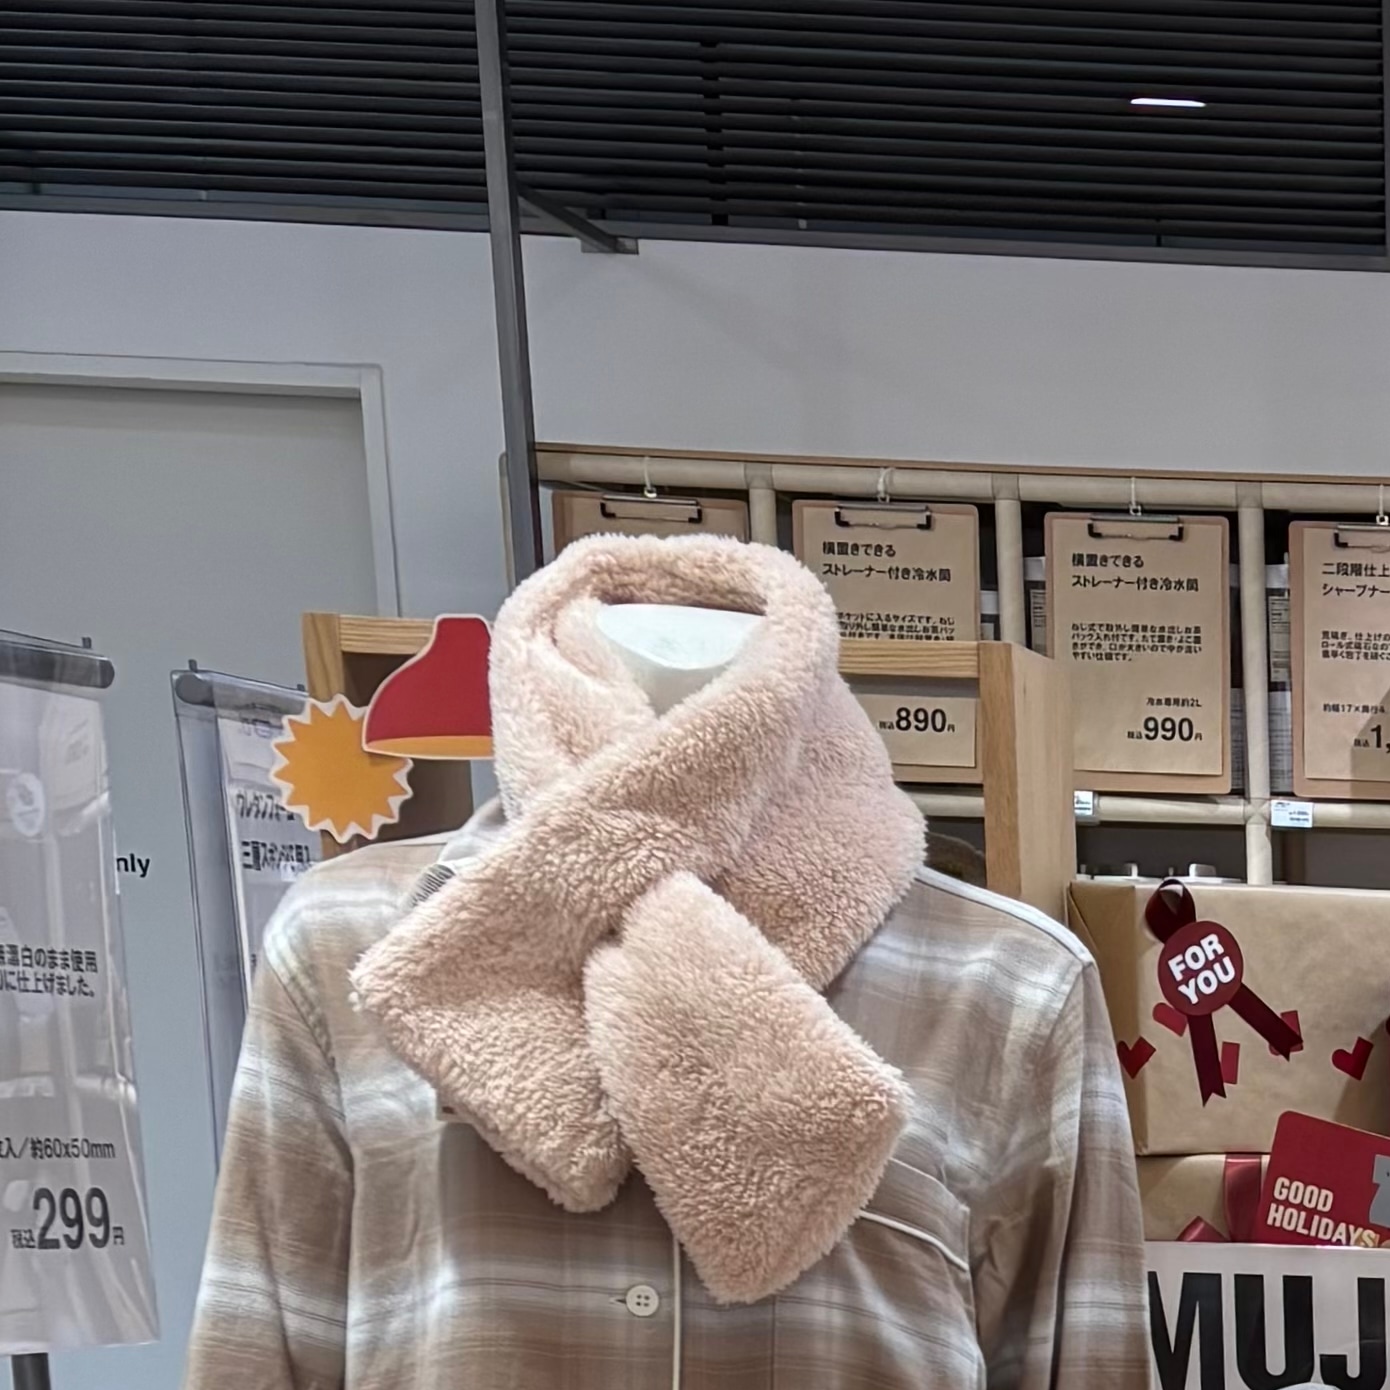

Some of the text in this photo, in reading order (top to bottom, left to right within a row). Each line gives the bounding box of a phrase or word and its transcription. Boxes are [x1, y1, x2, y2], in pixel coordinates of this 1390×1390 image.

[1127, 716, 1203, 742] 税込990円
[1166, 932, 1226, 983] FOR
[1176, 956, 1238, 1006] YOU
[10, 1186, 125, 1251] 税込299円
[1272, 1176, 1335, 1213] GOOD
[1266, 1202, 1380, 1249] HOLIDAYS
